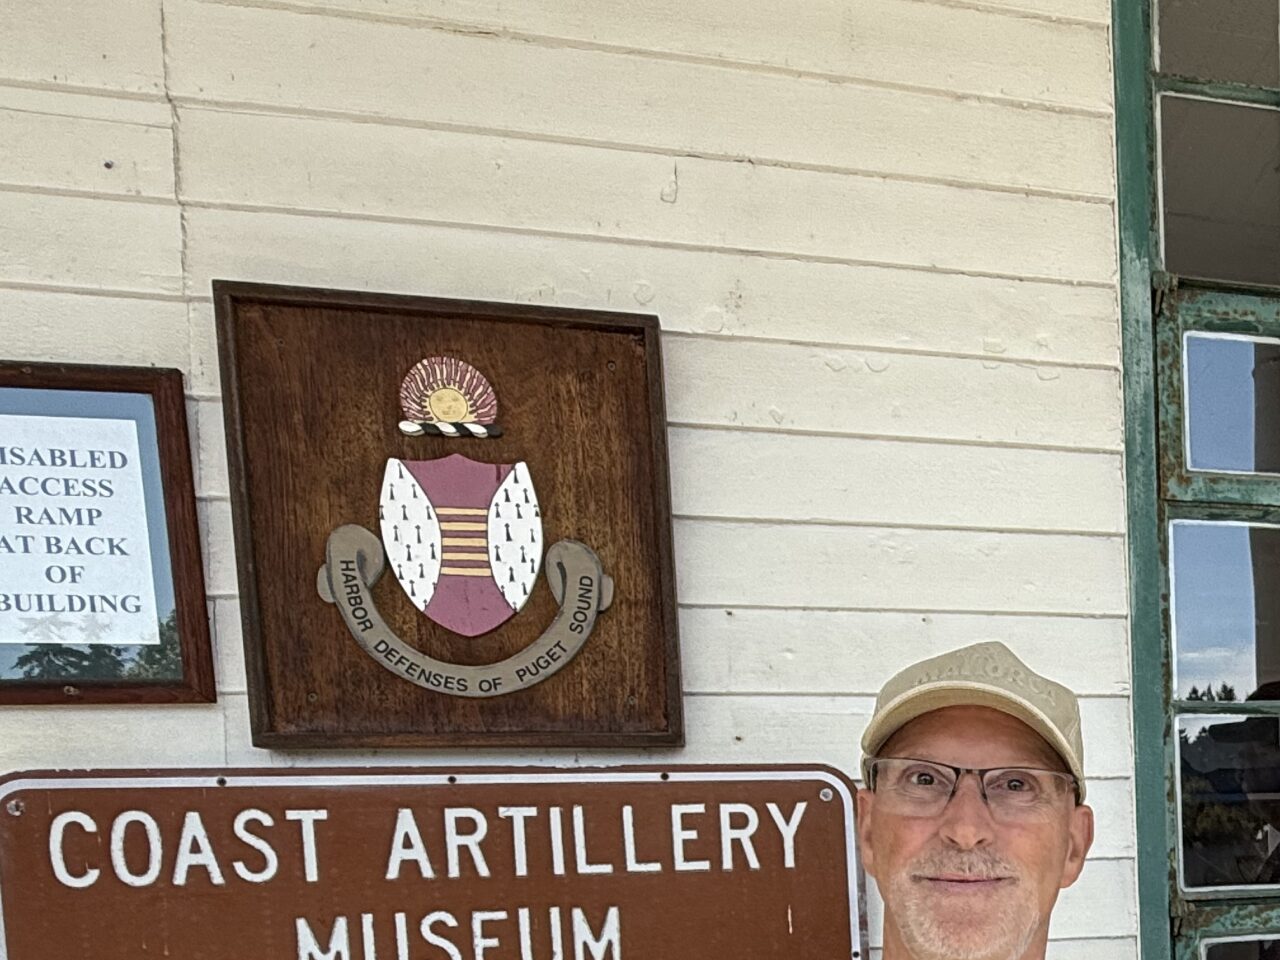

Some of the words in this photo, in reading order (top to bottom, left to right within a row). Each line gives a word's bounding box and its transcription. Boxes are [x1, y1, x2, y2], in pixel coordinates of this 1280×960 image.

[0, 476, 114, 498] ACCESS
[13, 506, 103, 526] RAMP
[0, 535, 35, 554] AT
[43, 536, 130, 556] BACK
[45, 565, 85, 584] OF
[339, 559, 374, 632] HARBOR
[373, 639, 469, 691] DEFENSES
[478, 676, 503, 693] OF
[515, 640, 568, 682] PUGET
[569, 575, 594, 634] SOUND
[49, 808, 328, 888] COAST
[385, 801, 808, 881] ARTILLERY
